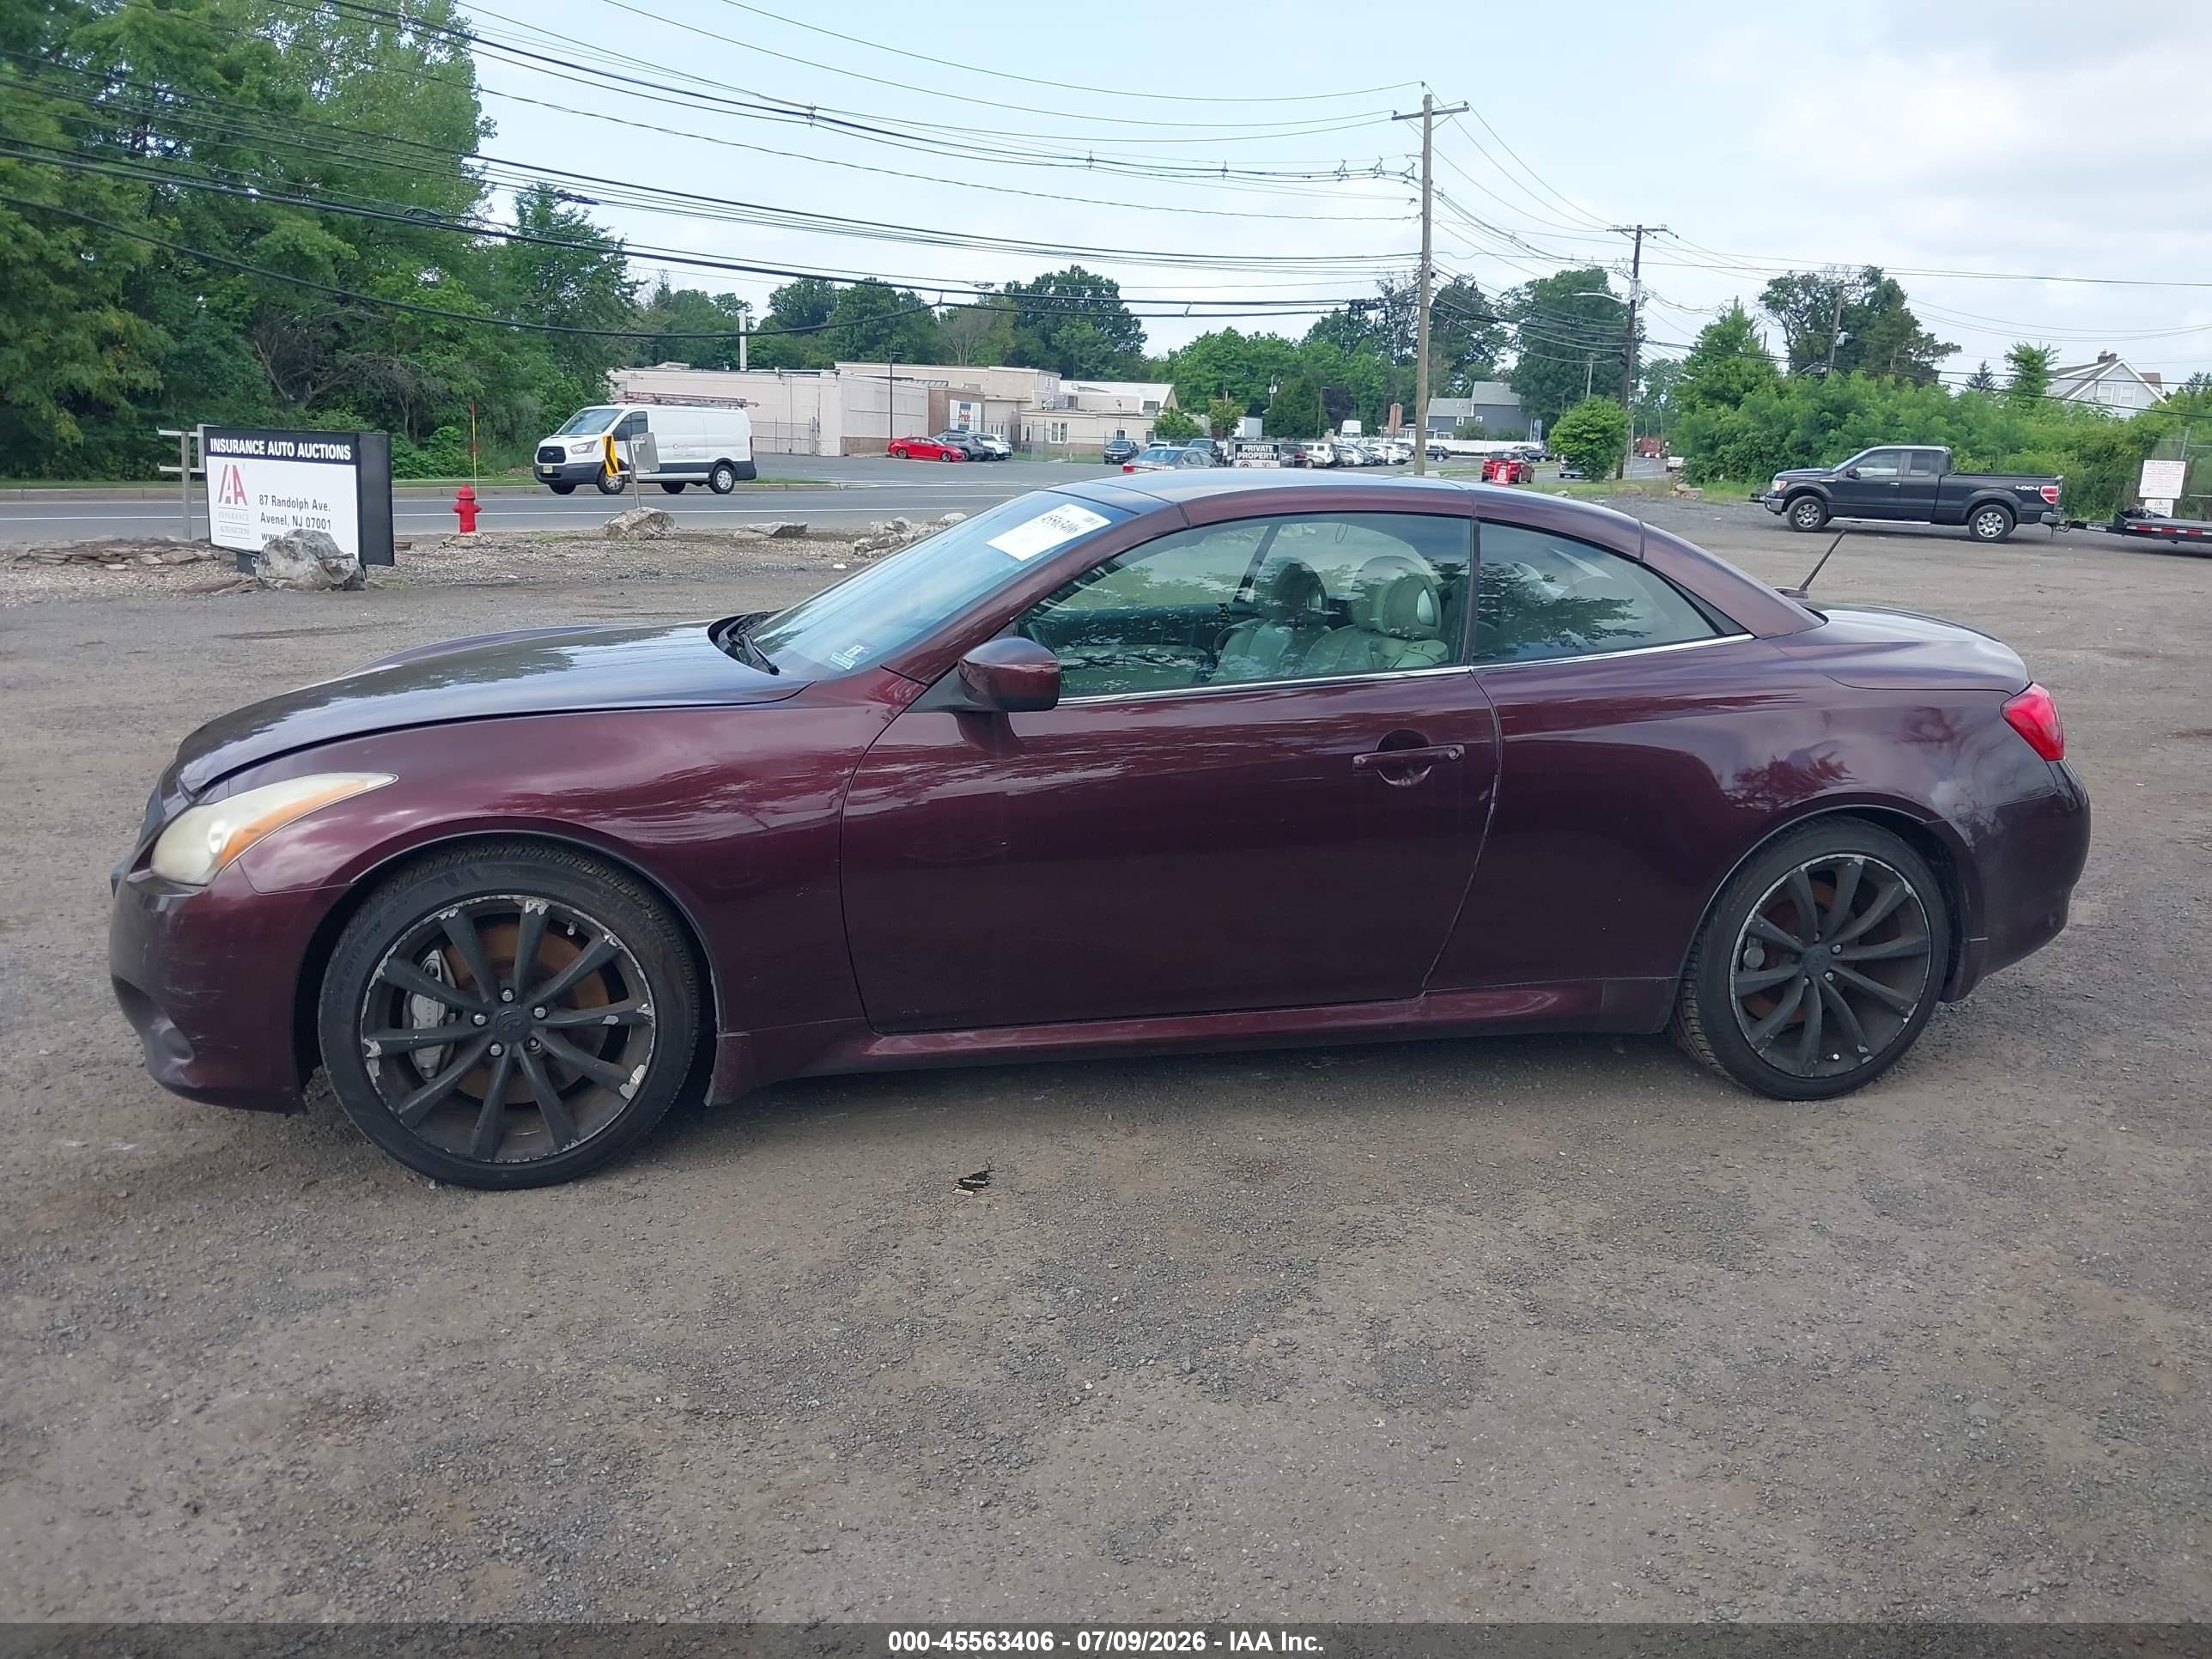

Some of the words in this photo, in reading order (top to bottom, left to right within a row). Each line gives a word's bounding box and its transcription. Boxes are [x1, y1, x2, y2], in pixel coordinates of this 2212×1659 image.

[210, 438, 265, 455] INSURANCE
[267, 441, 295, 457] AUTO
[297, 442, 351, 460] AUCTIONS
[1237, 452, 1278, 460] PROPERTY
[259, 494, 268, 506] 87
[271, 495, 309, 513] Randolph
[312, 499, 331, 512] Ave.
[260, 512, 289, 527] Avenel,
[292, 514, 303, 527] NJ
[306, 516, 331, 530] 07001
